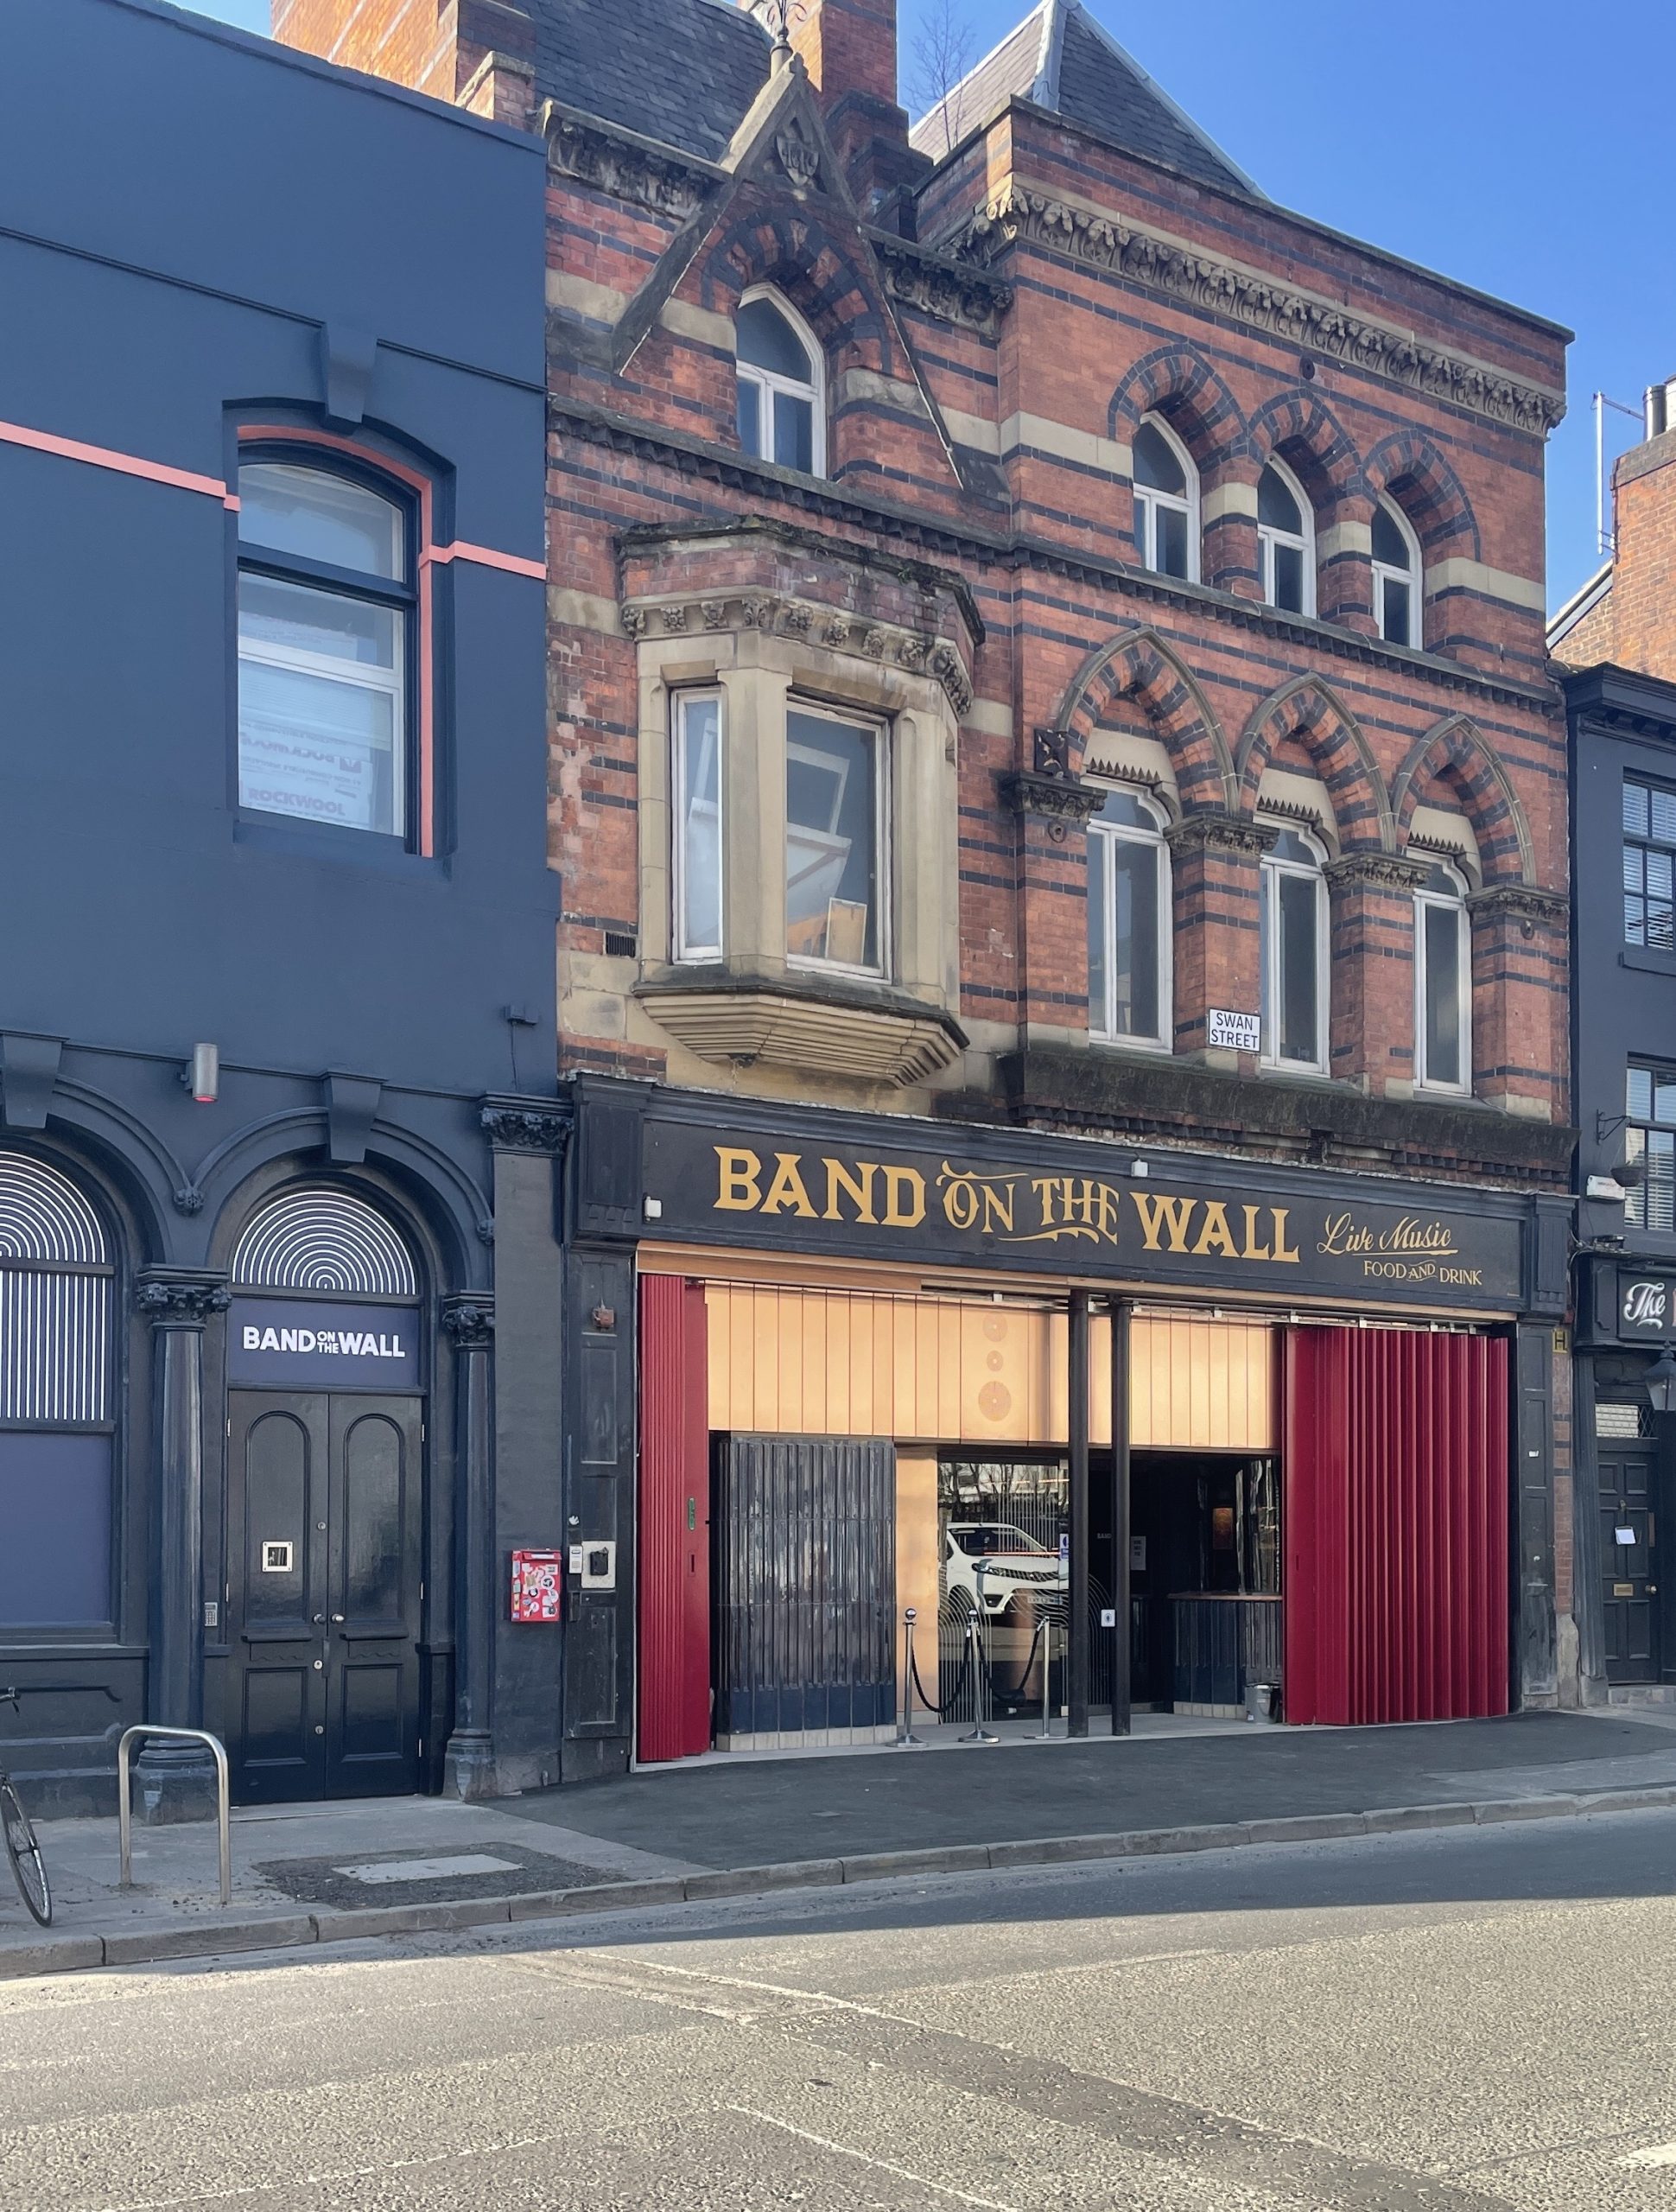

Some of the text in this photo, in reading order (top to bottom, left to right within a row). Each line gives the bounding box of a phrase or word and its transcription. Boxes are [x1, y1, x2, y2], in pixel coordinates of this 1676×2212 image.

[1216, 1012, 1253, 1031] SWAN
[1211, 1029, 1258, 1048] STREET
[713, 1146, 1300, 1263] BAND ON THE WALL
[1317, 1212, 1452, 1255] Live Music
[1363, 1260, 1482, 1285] FOOD AND DRINK
[1623, 1282, 1666, 1321] The
[243, 1325, 405, 1357] BAND ON THE WALL
[1554, 1332, 1565, 1351] H
